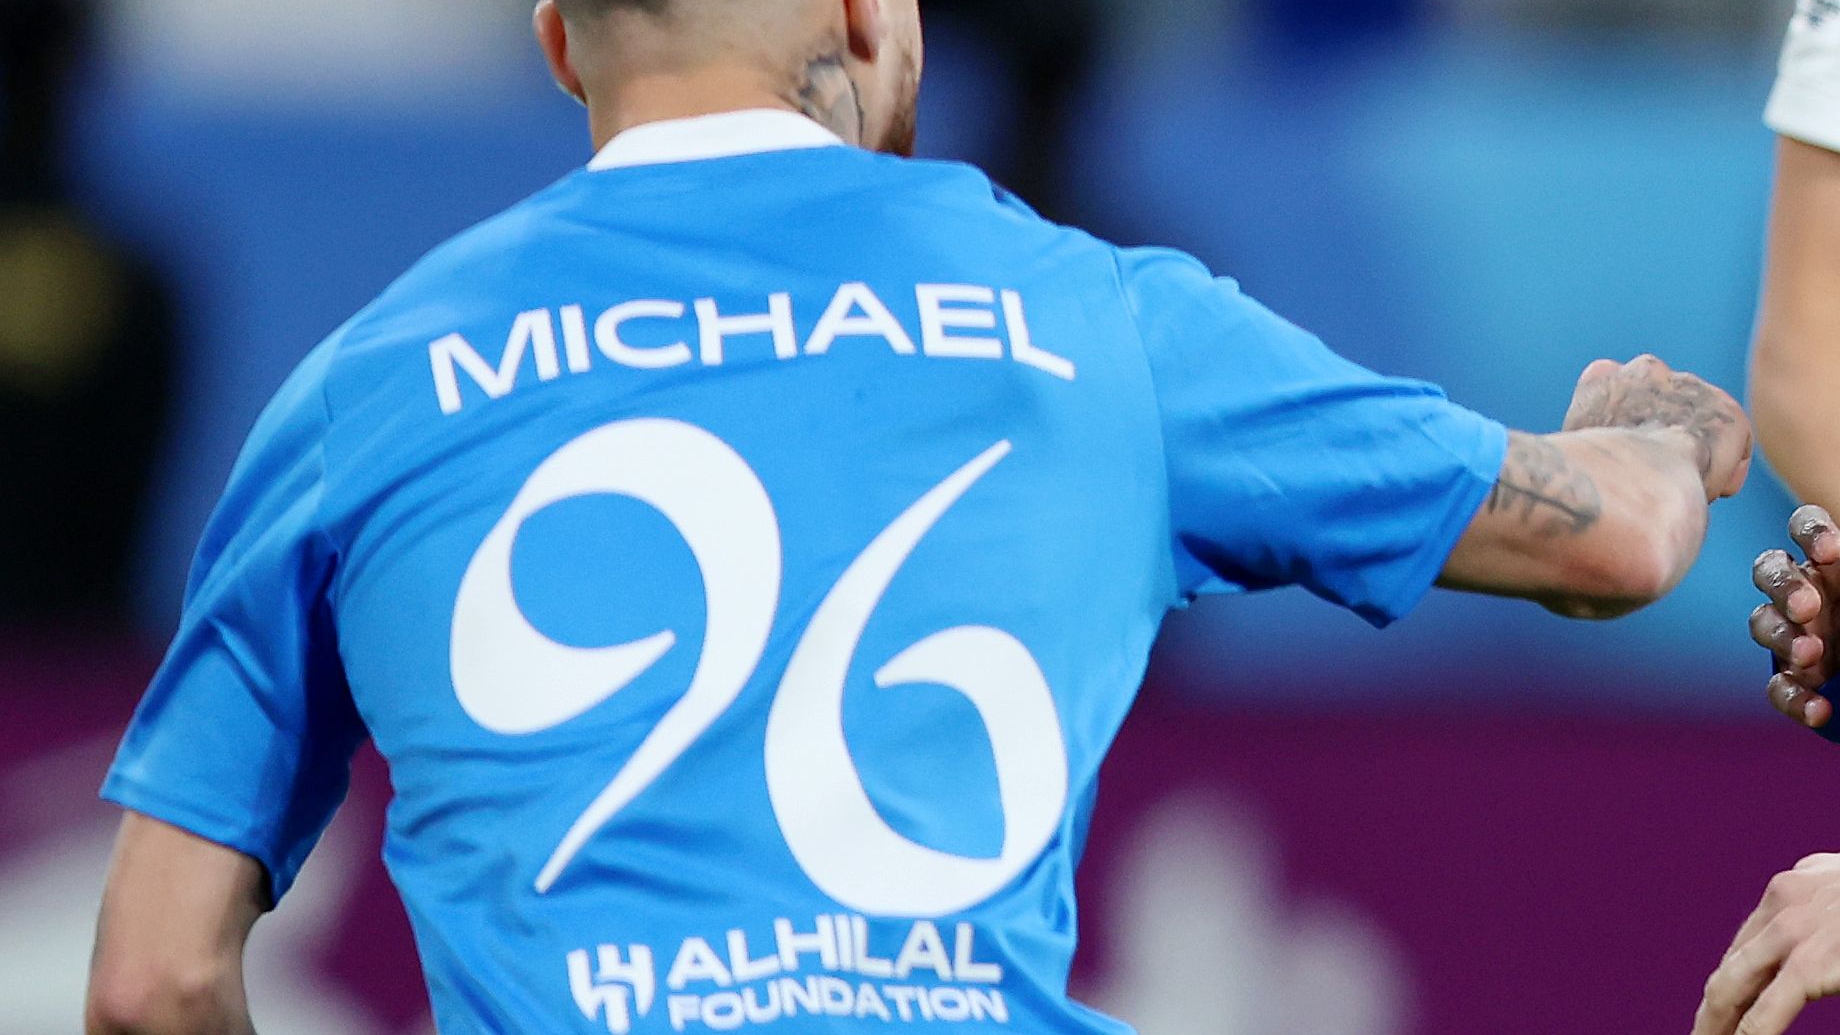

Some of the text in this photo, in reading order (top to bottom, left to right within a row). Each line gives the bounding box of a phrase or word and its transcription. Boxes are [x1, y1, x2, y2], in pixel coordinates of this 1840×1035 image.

[428, 282, 1075, 415] MICHAEL
[449, 417, 1068, 918] 96
[667, 976, 1009, 1032] FOUNDATION
